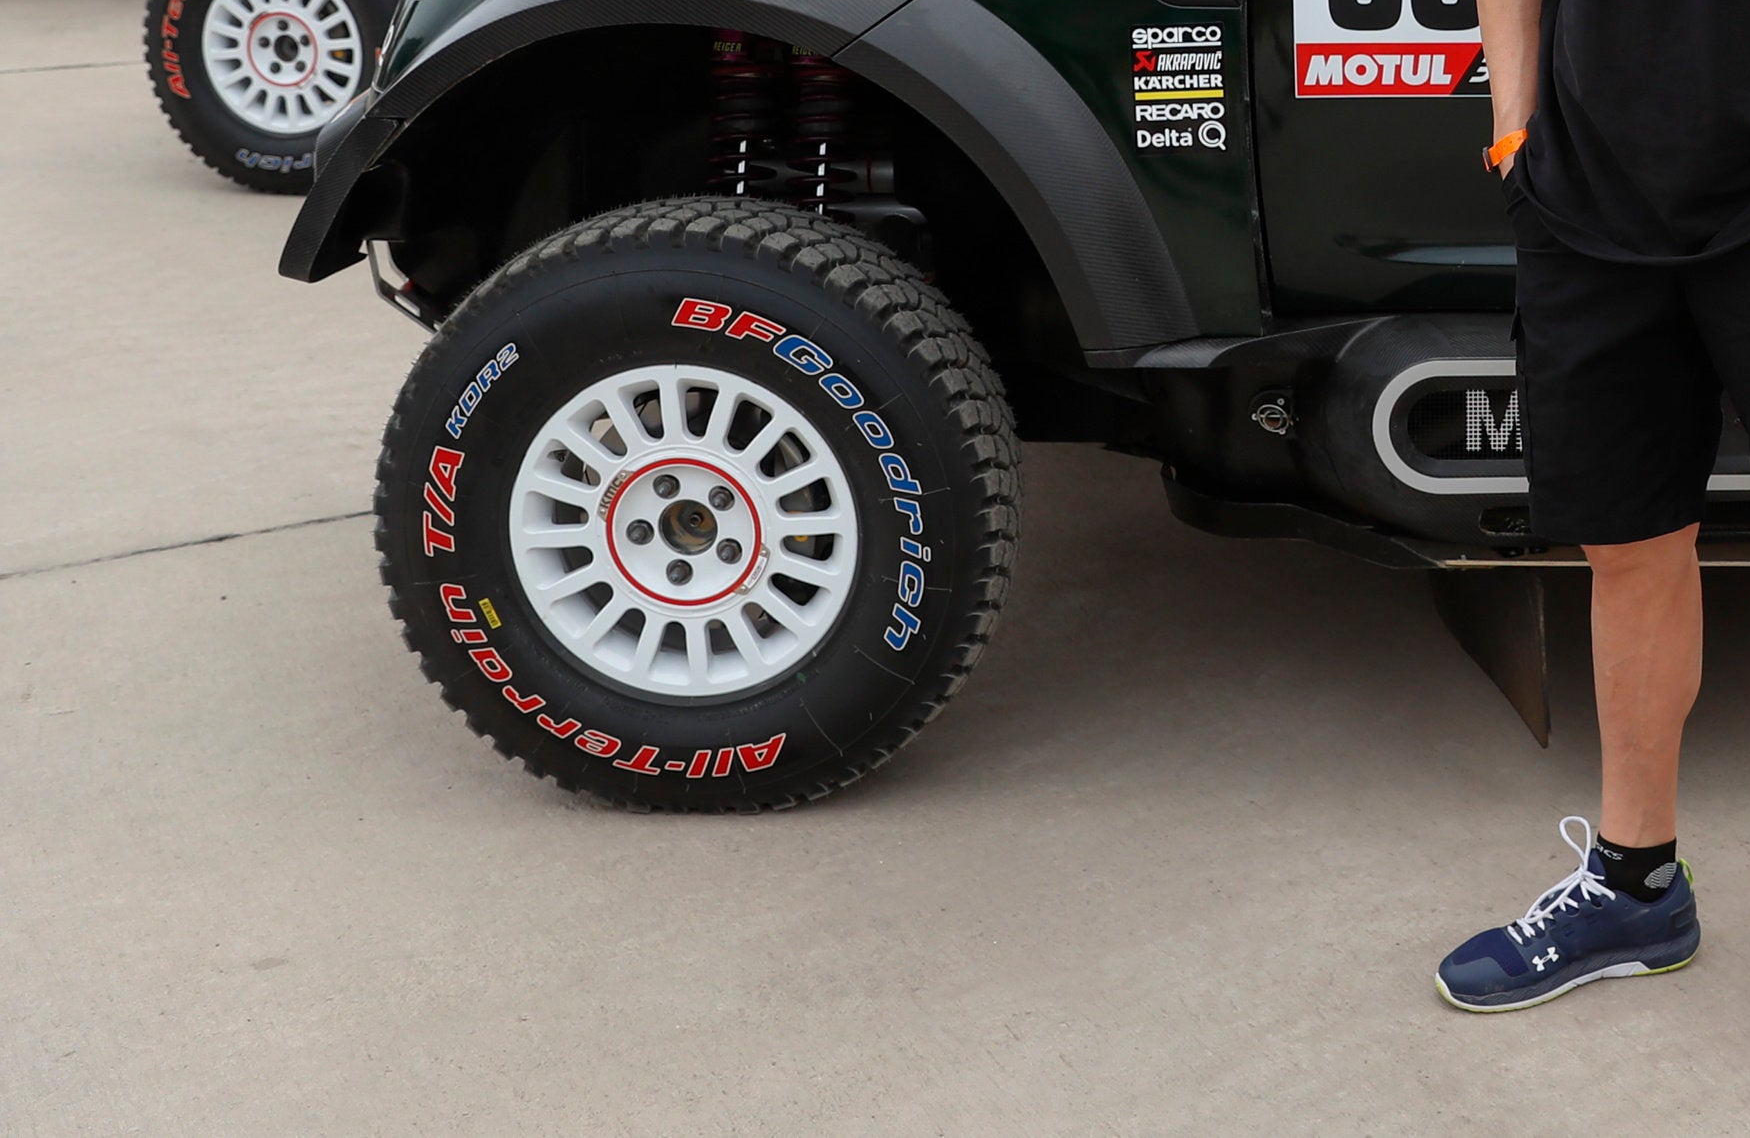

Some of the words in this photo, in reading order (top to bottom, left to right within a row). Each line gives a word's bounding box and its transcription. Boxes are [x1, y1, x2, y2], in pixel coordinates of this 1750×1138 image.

[1132, 26, 1222, 49] sparco
[1134, 74, 1224, 90] KÄRCHER
[1304, 54, 1453, 85] MOTUL
[1135, 102, 1225, 122] RECARO
[1136, 128, 1193, 148] Delta
[671, 297, 931, 651] BFGoodrich
[422, 445, 466, 557] T/A
[438, 583, 788, 780] All-Terrain
